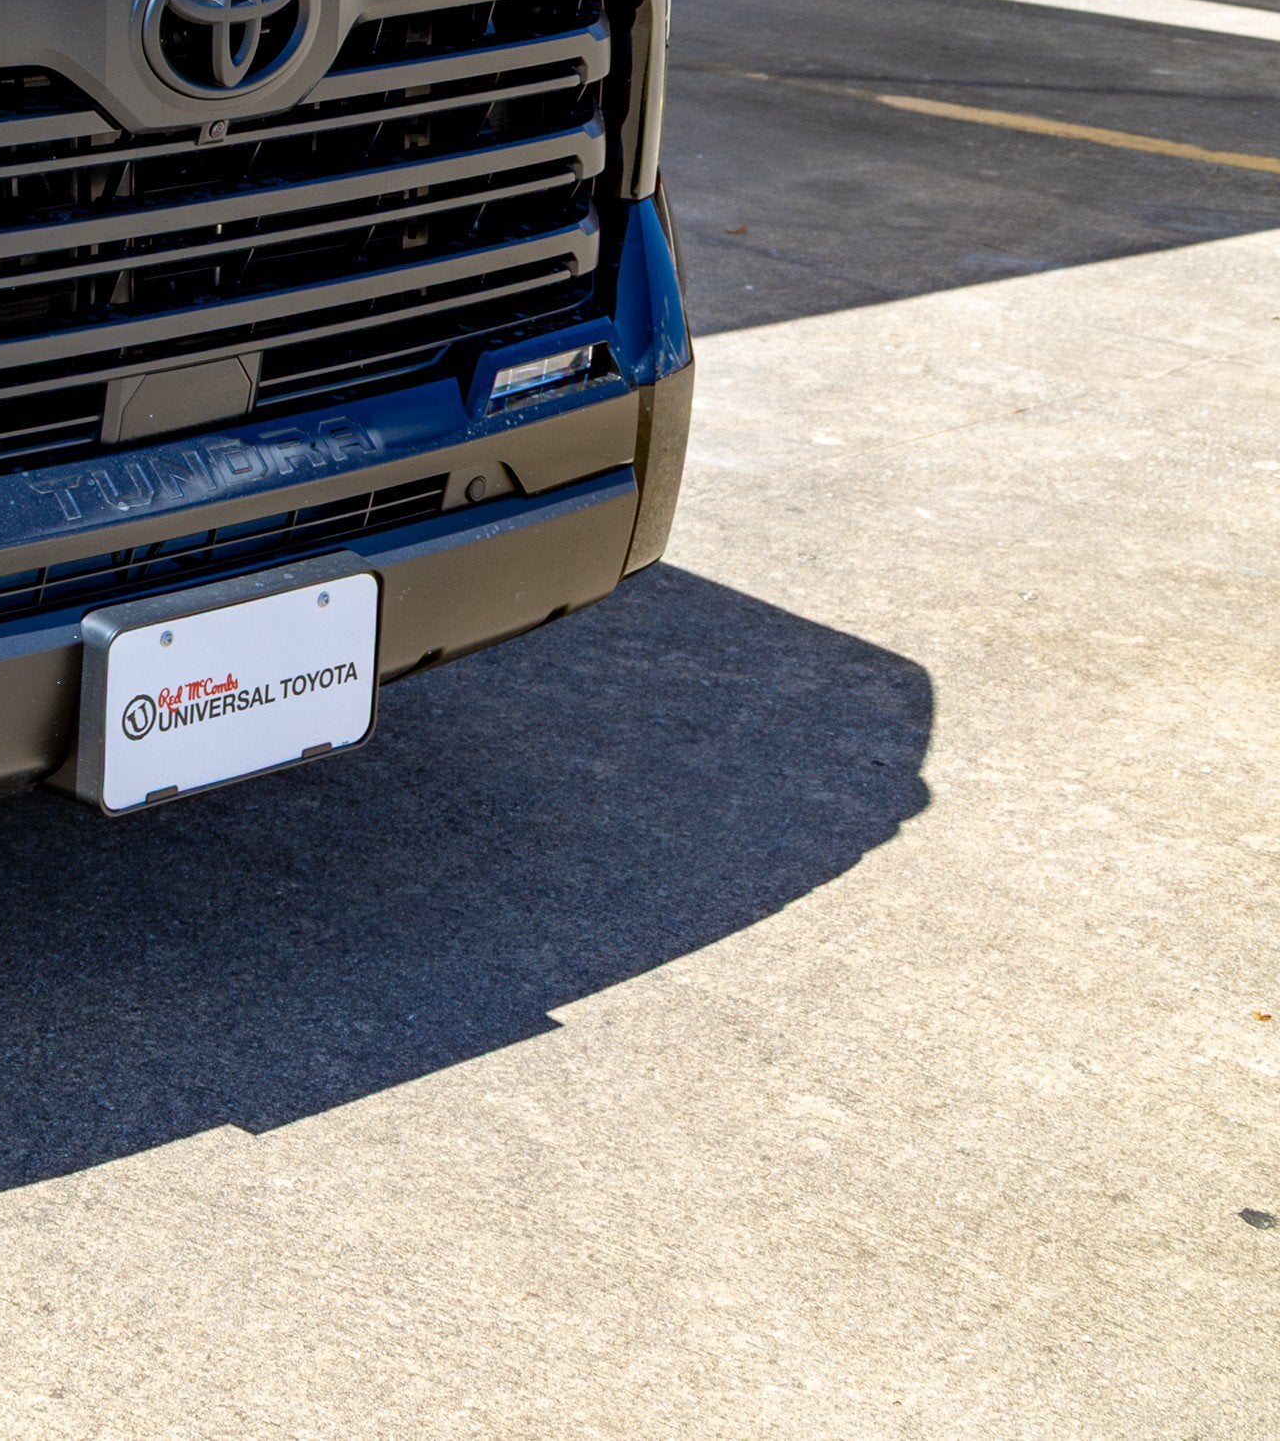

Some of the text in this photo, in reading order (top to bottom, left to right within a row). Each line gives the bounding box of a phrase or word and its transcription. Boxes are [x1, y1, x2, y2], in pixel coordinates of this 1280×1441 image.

[28, 415, 381, 521] TUNDRA
[158, 672, 239, 713] Red McCombs
[158, 660, 359, 733] UNIVERSAL TOYOTA
